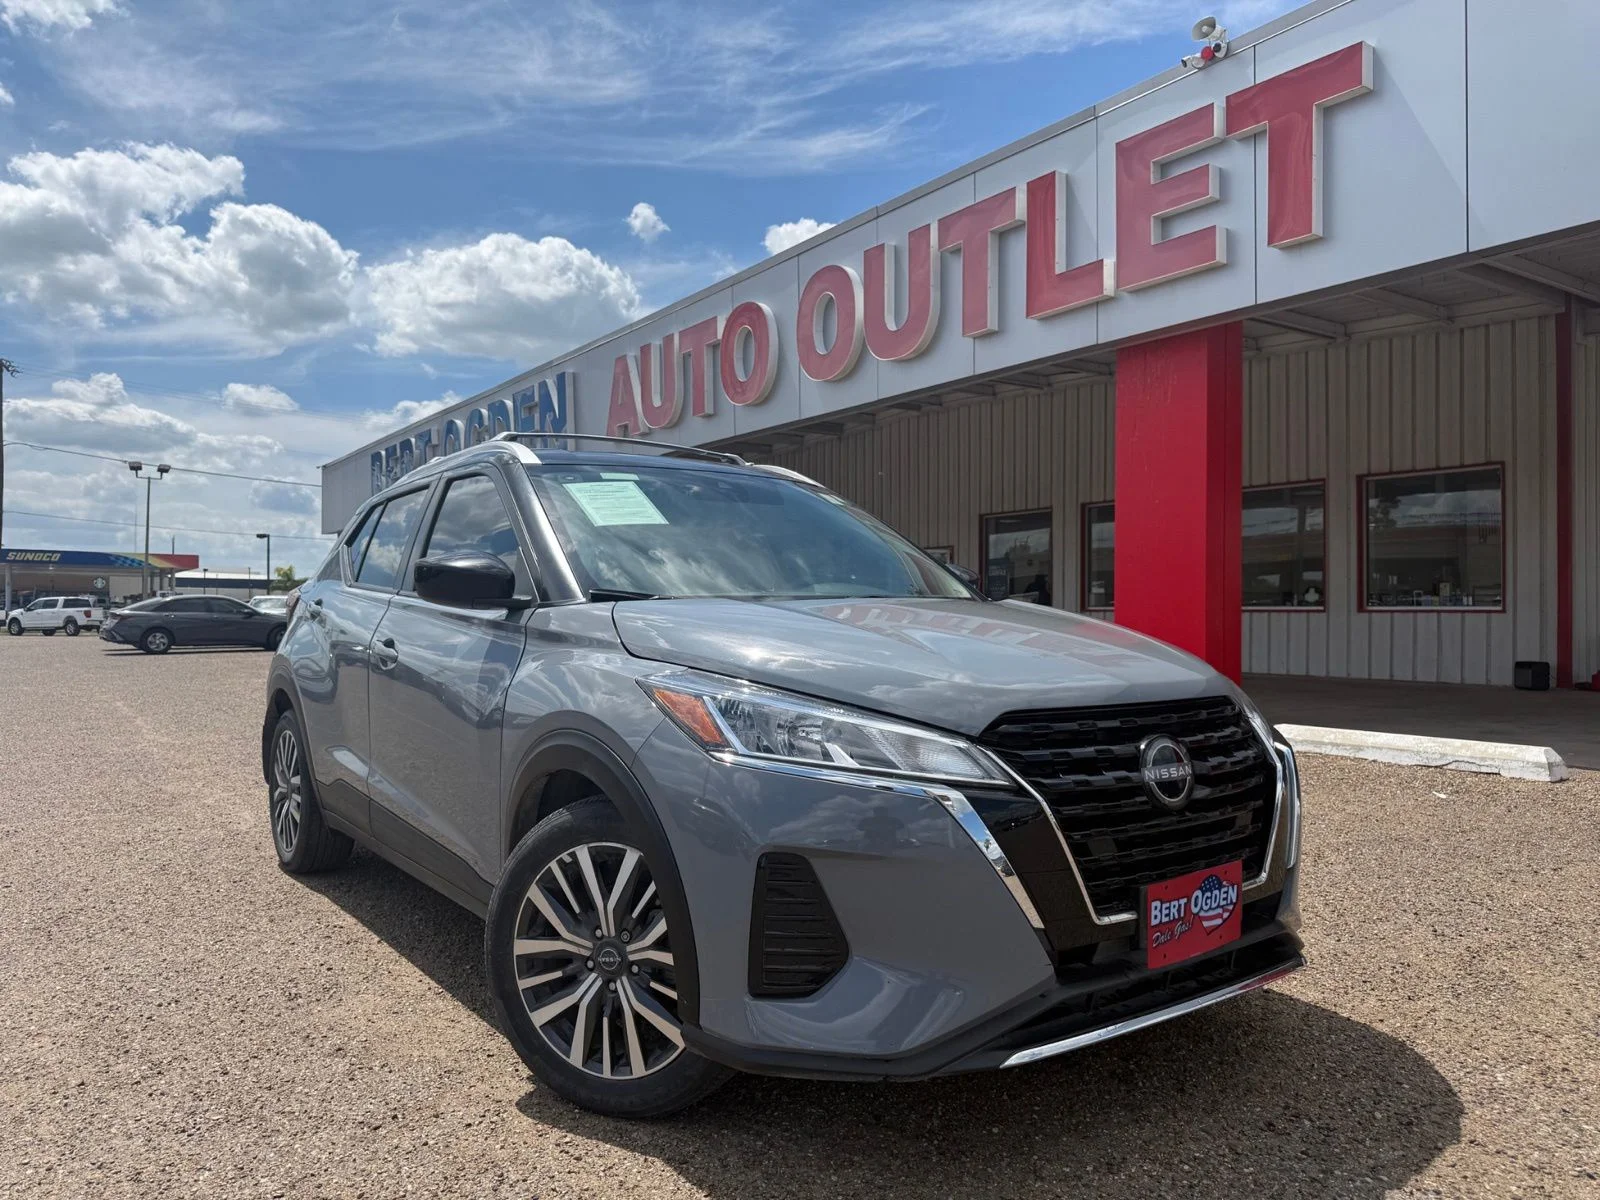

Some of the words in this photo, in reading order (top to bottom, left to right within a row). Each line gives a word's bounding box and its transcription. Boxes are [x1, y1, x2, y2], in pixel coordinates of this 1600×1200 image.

[371, 428, 437, 497] BERT
[443, 371, 575, 453] OGDEN
[606, 301, 779, 437] AUTO
[796, 41, 1374, 382] OUTLET
[6, 551, 61, 562] SUNOCO
[1144, 764, 1192, 780] NISSAN
[1150, 897, 1188, 927] BERT
[1190, 884, 1238, 915] OGDEN
